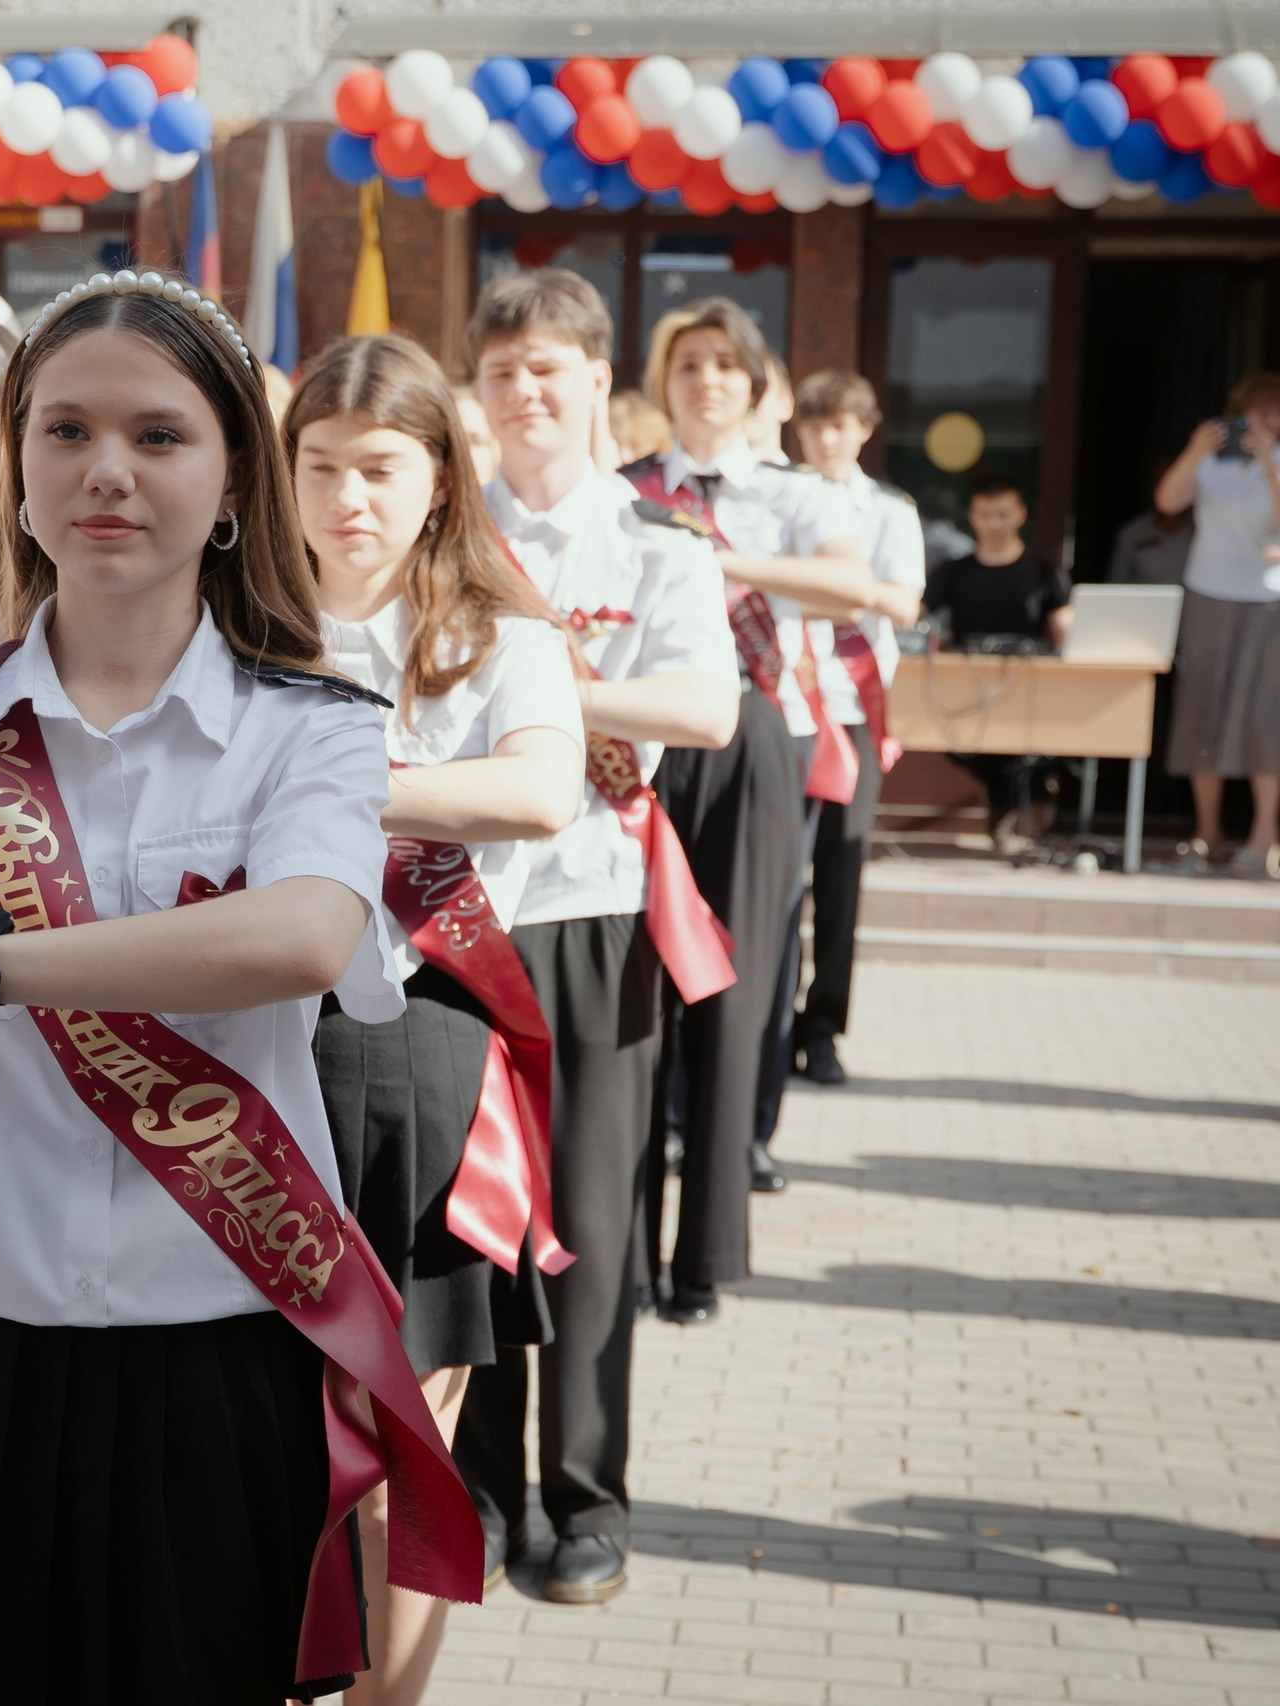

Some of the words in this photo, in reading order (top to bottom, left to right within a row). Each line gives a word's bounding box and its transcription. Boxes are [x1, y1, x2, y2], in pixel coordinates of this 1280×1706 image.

[402, 845, 503, 951] 2025
[132, 1083, 241, 1148] 9
[187, 1130, 335, 1303] КЛАССА
